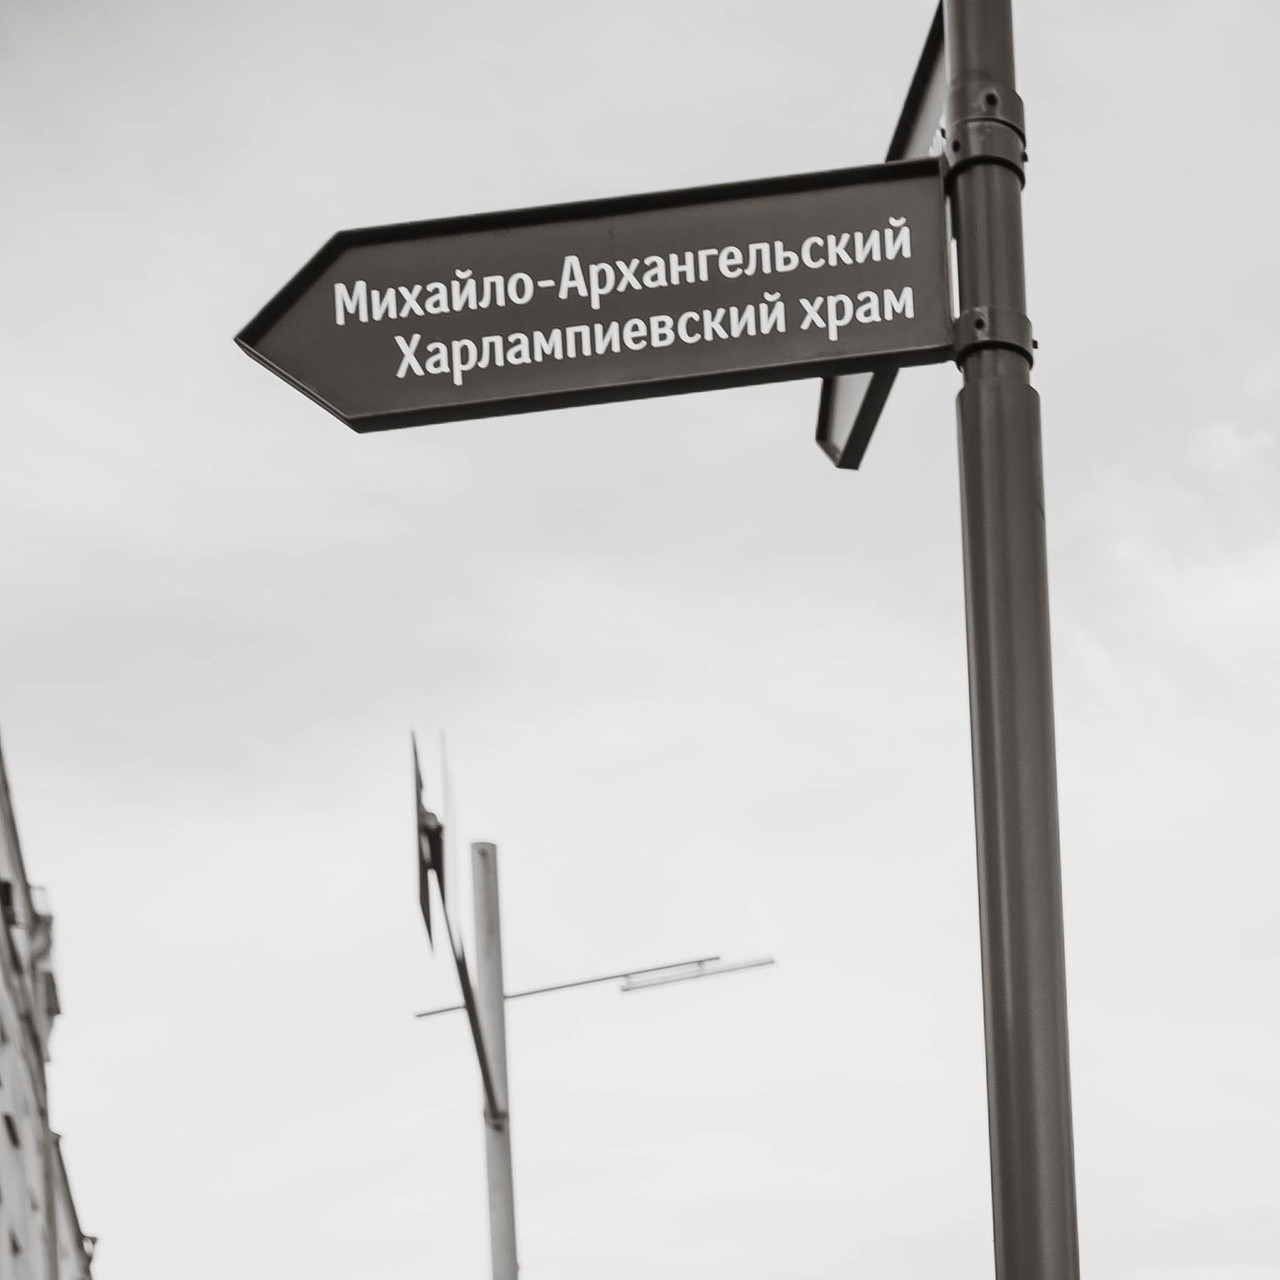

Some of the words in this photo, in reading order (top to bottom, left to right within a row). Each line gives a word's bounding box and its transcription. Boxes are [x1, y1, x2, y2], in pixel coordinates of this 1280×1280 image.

[334, 216, 912, 326] Михайло-Архангельский
[394, 291, 786, 386] Харлампиевский
[798, 286, 915, 342] храм
